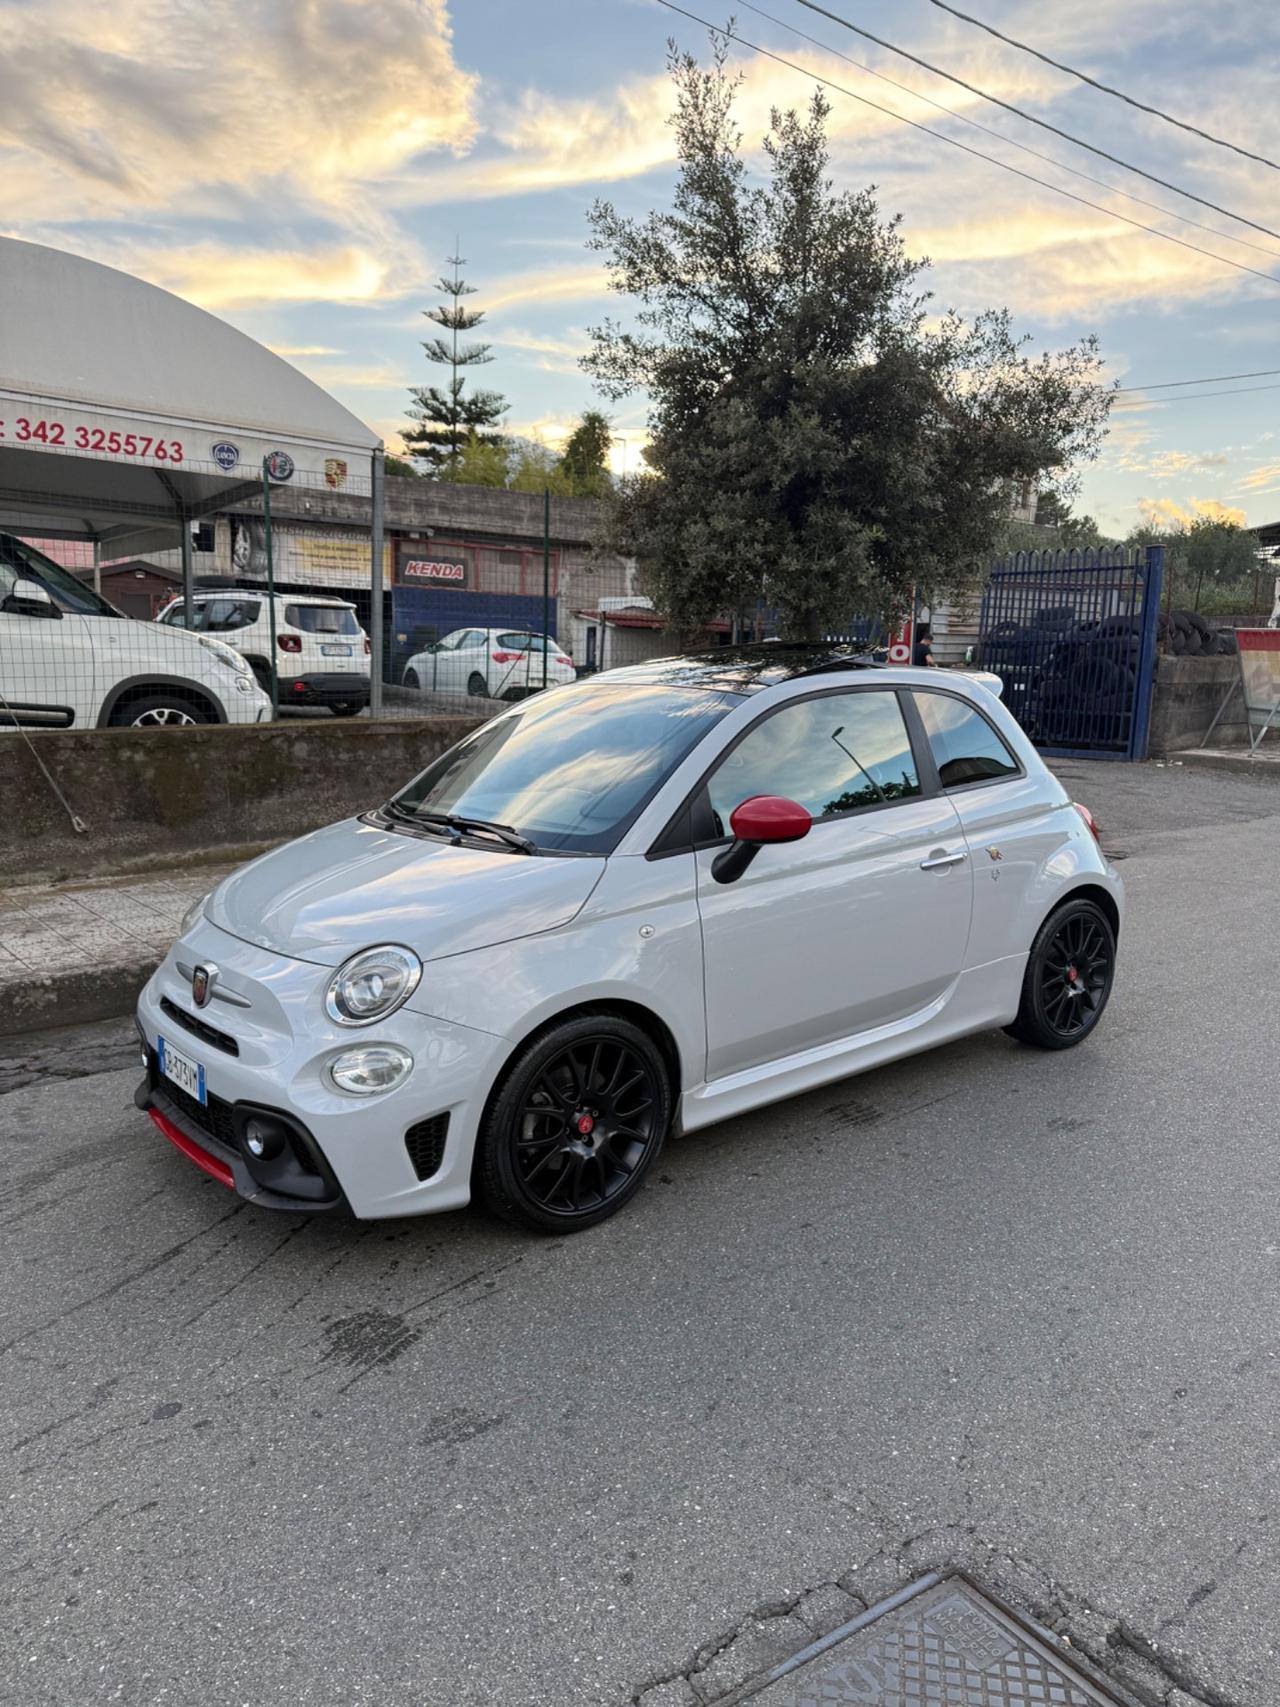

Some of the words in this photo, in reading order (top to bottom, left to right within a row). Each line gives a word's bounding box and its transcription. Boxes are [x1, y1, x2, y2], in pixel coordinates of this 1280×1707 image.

[15, 418, 65, 446] 342
[74, 426, 184, 463] 3255763
[405, 560, 464, 580] KENDA
